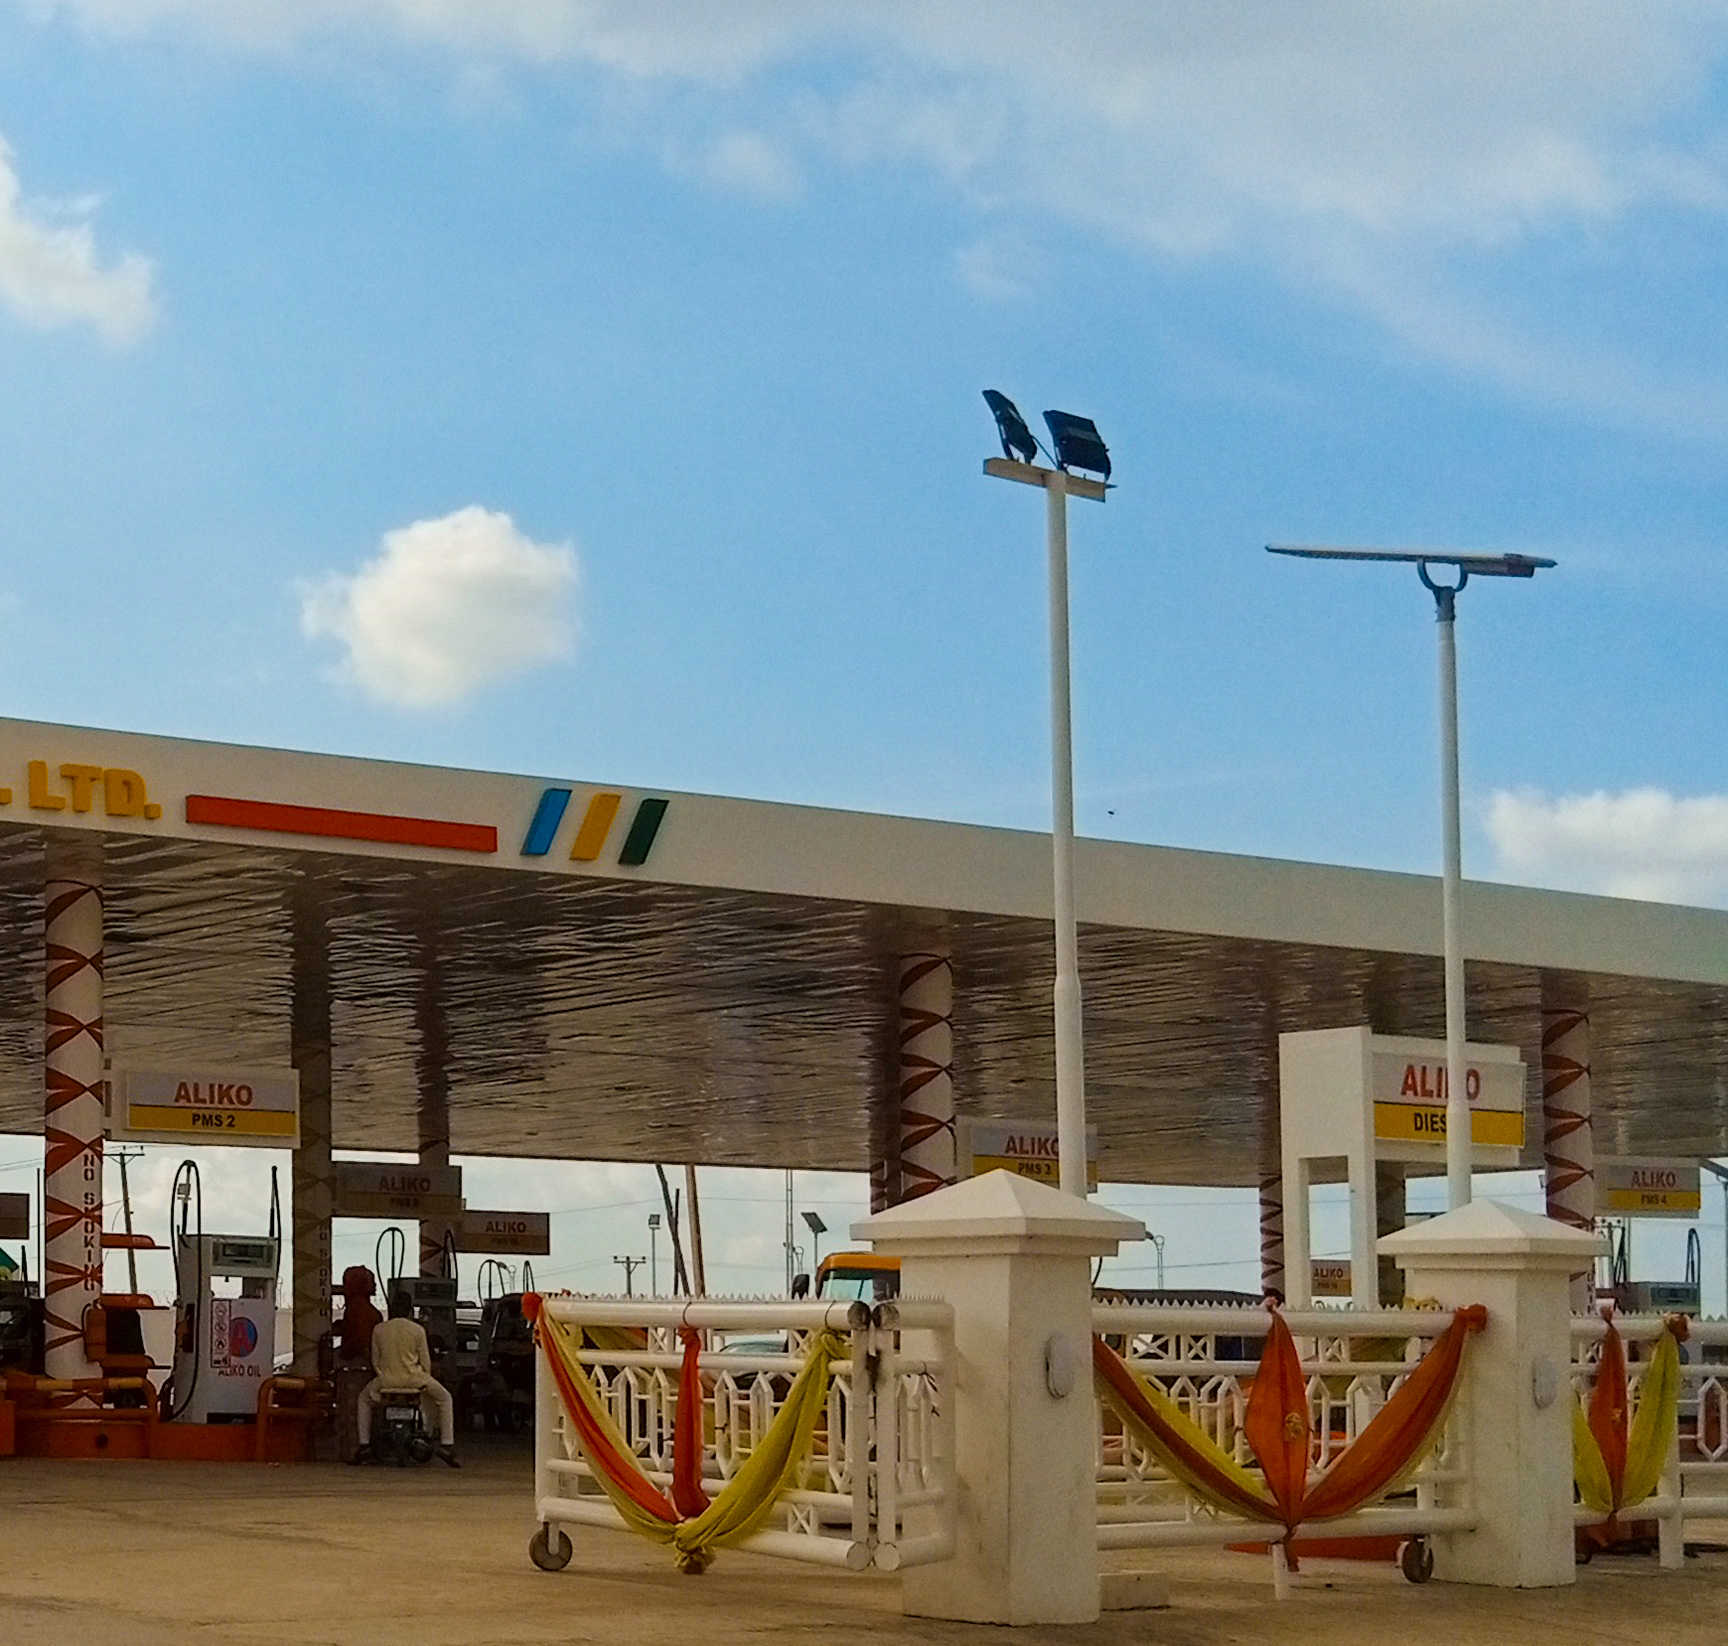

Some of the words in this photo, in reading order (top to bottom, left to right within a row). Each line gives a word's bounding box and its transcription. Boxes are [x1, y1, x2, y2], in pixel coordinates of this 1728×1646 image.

[28, 760, 161, 819] LTD.
[1400, 1064, 1481, 1100] ALIO
[173, 1081, 254, 1106] ALIKO
[192, 1113, 223, 1127] PMS
[226, 1114, 236, 1127] 2
[1414, 1112, 1447, 1133] DIES
[83, 1154, 95, 1181] NO
[1018, 1162, 1043, 1175] PMS
[1045, 1163, 1051, 1175] 3
[378, 1175, 431, 1192] ALIKO
[1631, 1170, 1677, 1188] ALIKO
[485, 1220, 527, 1234] ALIKO
[1313, 1267, 1344, 1279] ALIKO
[319, 1248, 329, 1317] SOKIG
[218, 1364, 245, 1377] ALIKO
[247, 1365, 262, 1377] OIL
